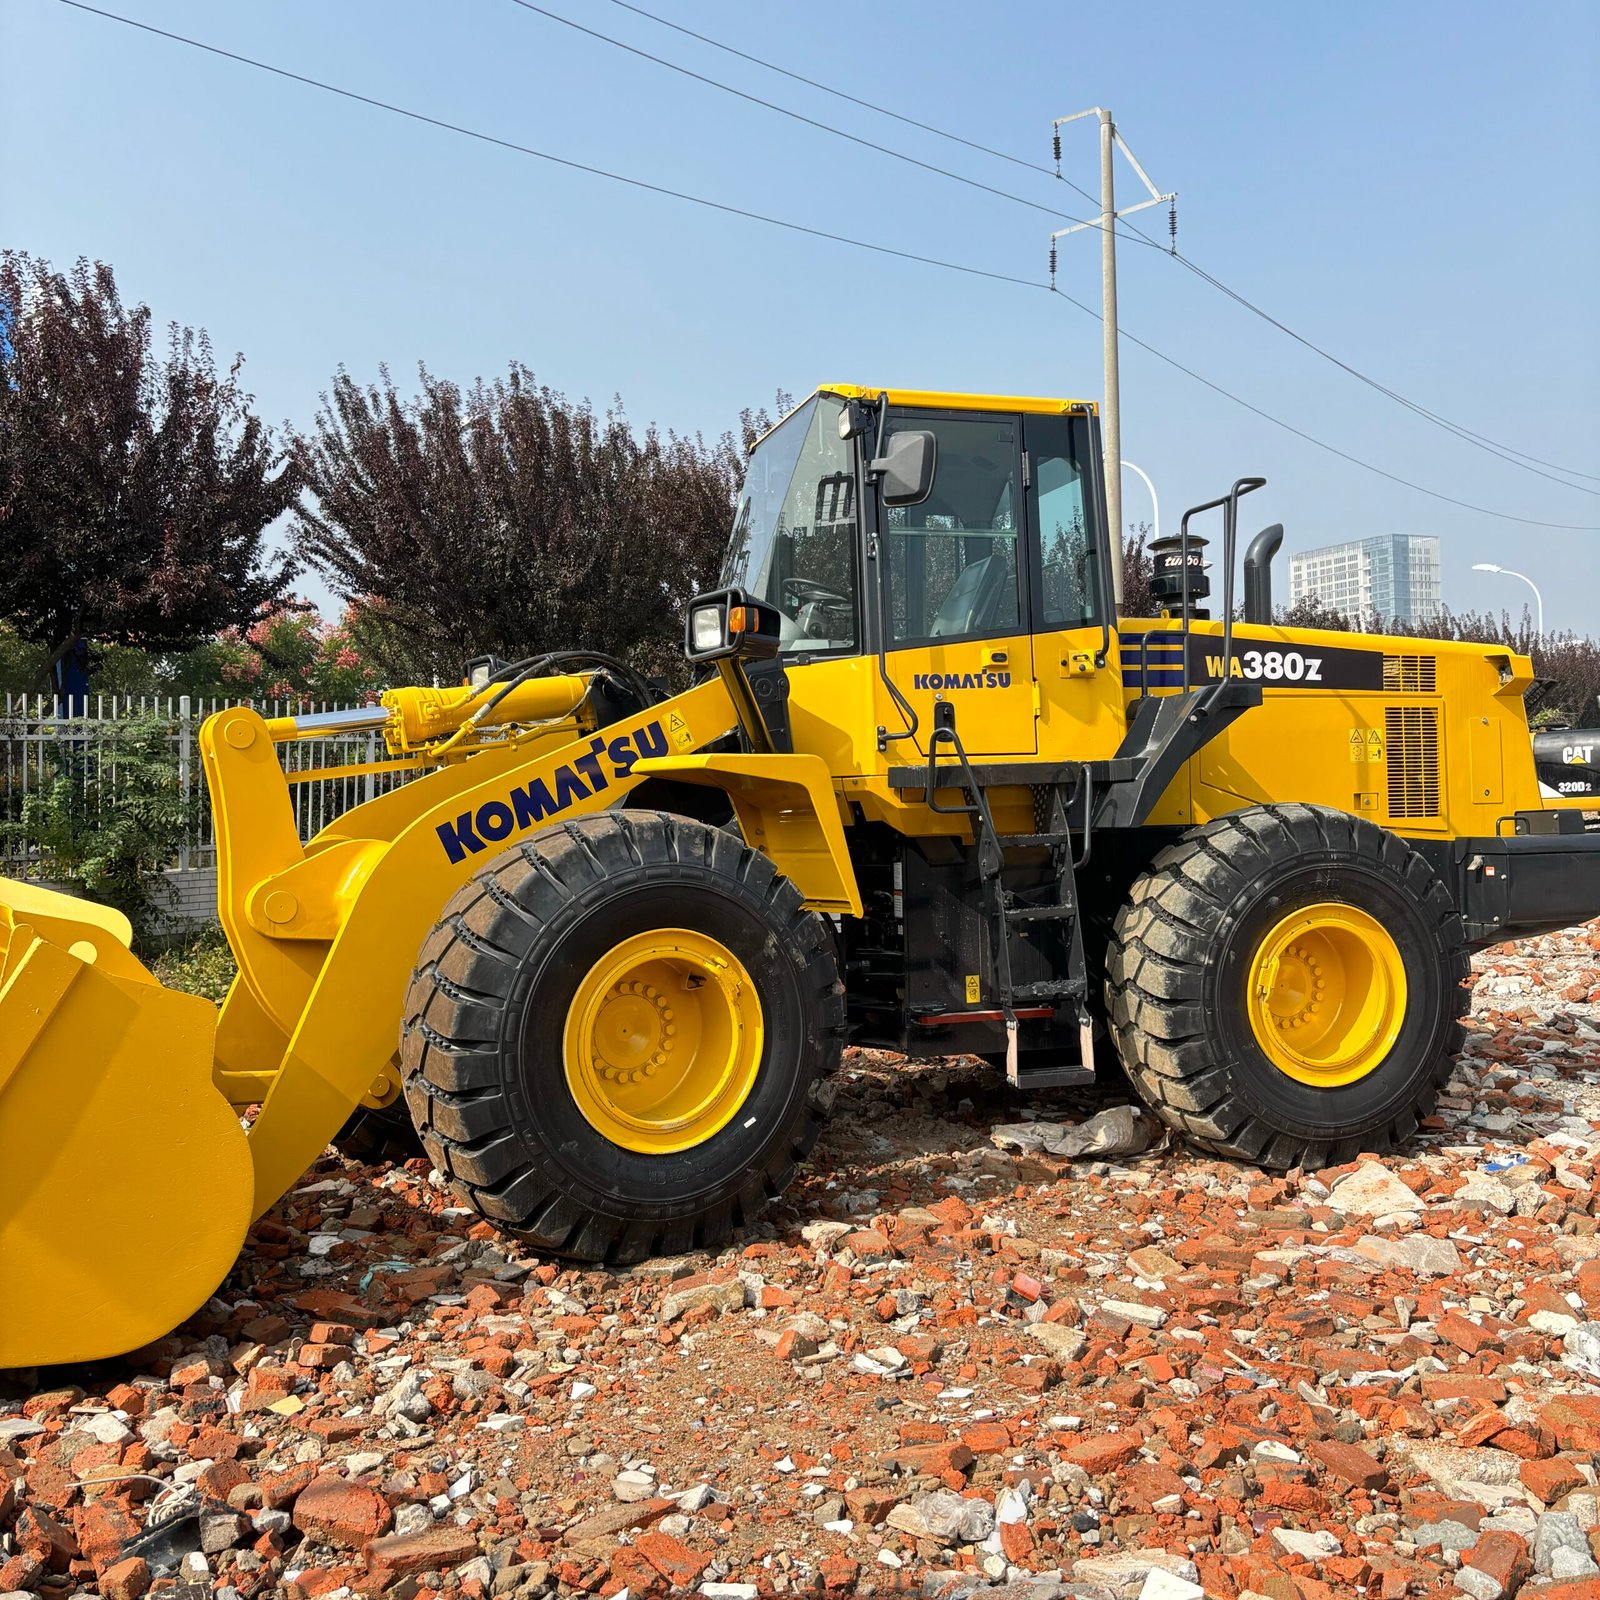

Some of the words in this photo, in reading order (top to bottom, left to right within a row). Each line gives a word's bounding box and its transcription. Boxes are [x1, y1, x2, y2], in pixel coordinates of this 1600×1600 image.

[914, 669, 1011, 689] KOMATSU
[1562, 745, 1594, 765] CAT
[435, 720, 669, 865] KOMATSU
